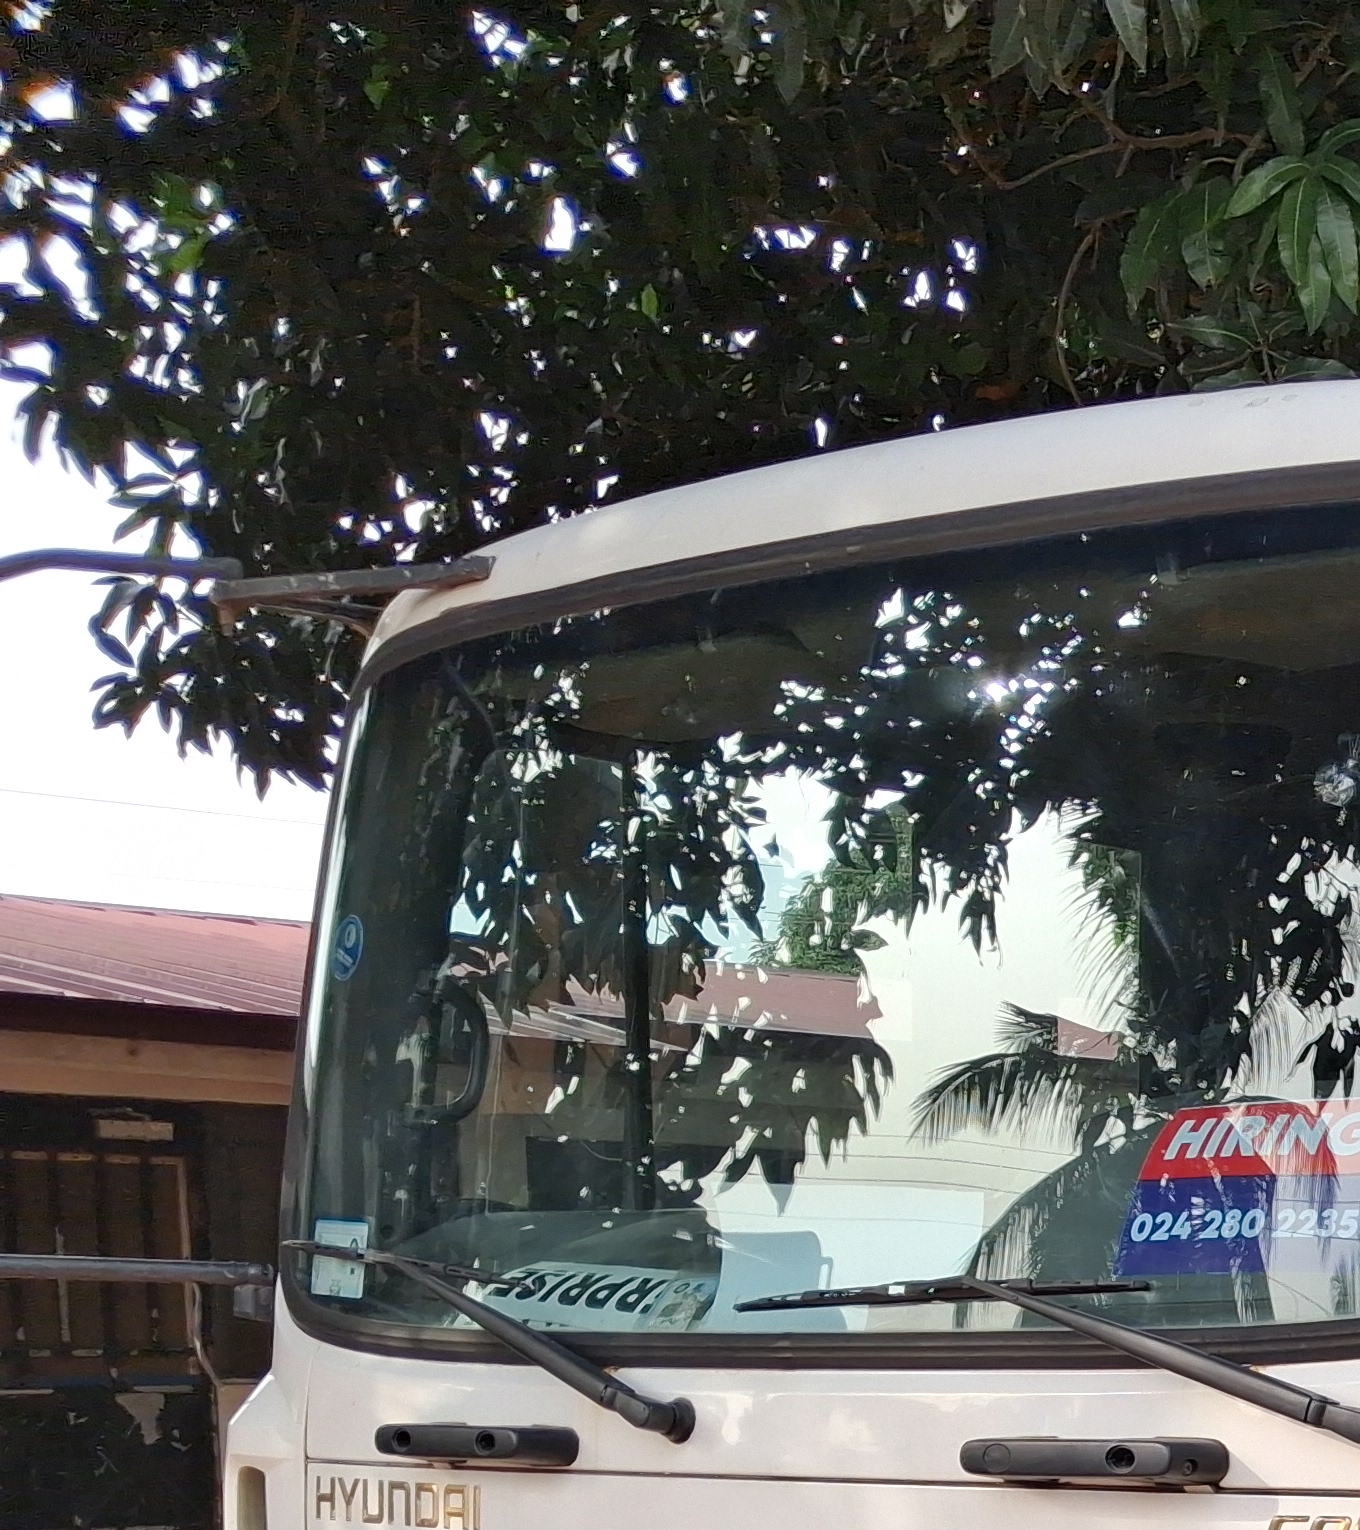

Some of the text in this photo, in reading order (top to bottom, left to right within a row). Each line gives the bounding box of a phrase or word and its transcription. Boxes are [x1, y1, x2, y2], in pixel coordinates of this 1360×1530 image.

[1130, 1208, 1360, 1243] 024 280 2235
[315, 1475, 482, 1530] HYUNDAI
